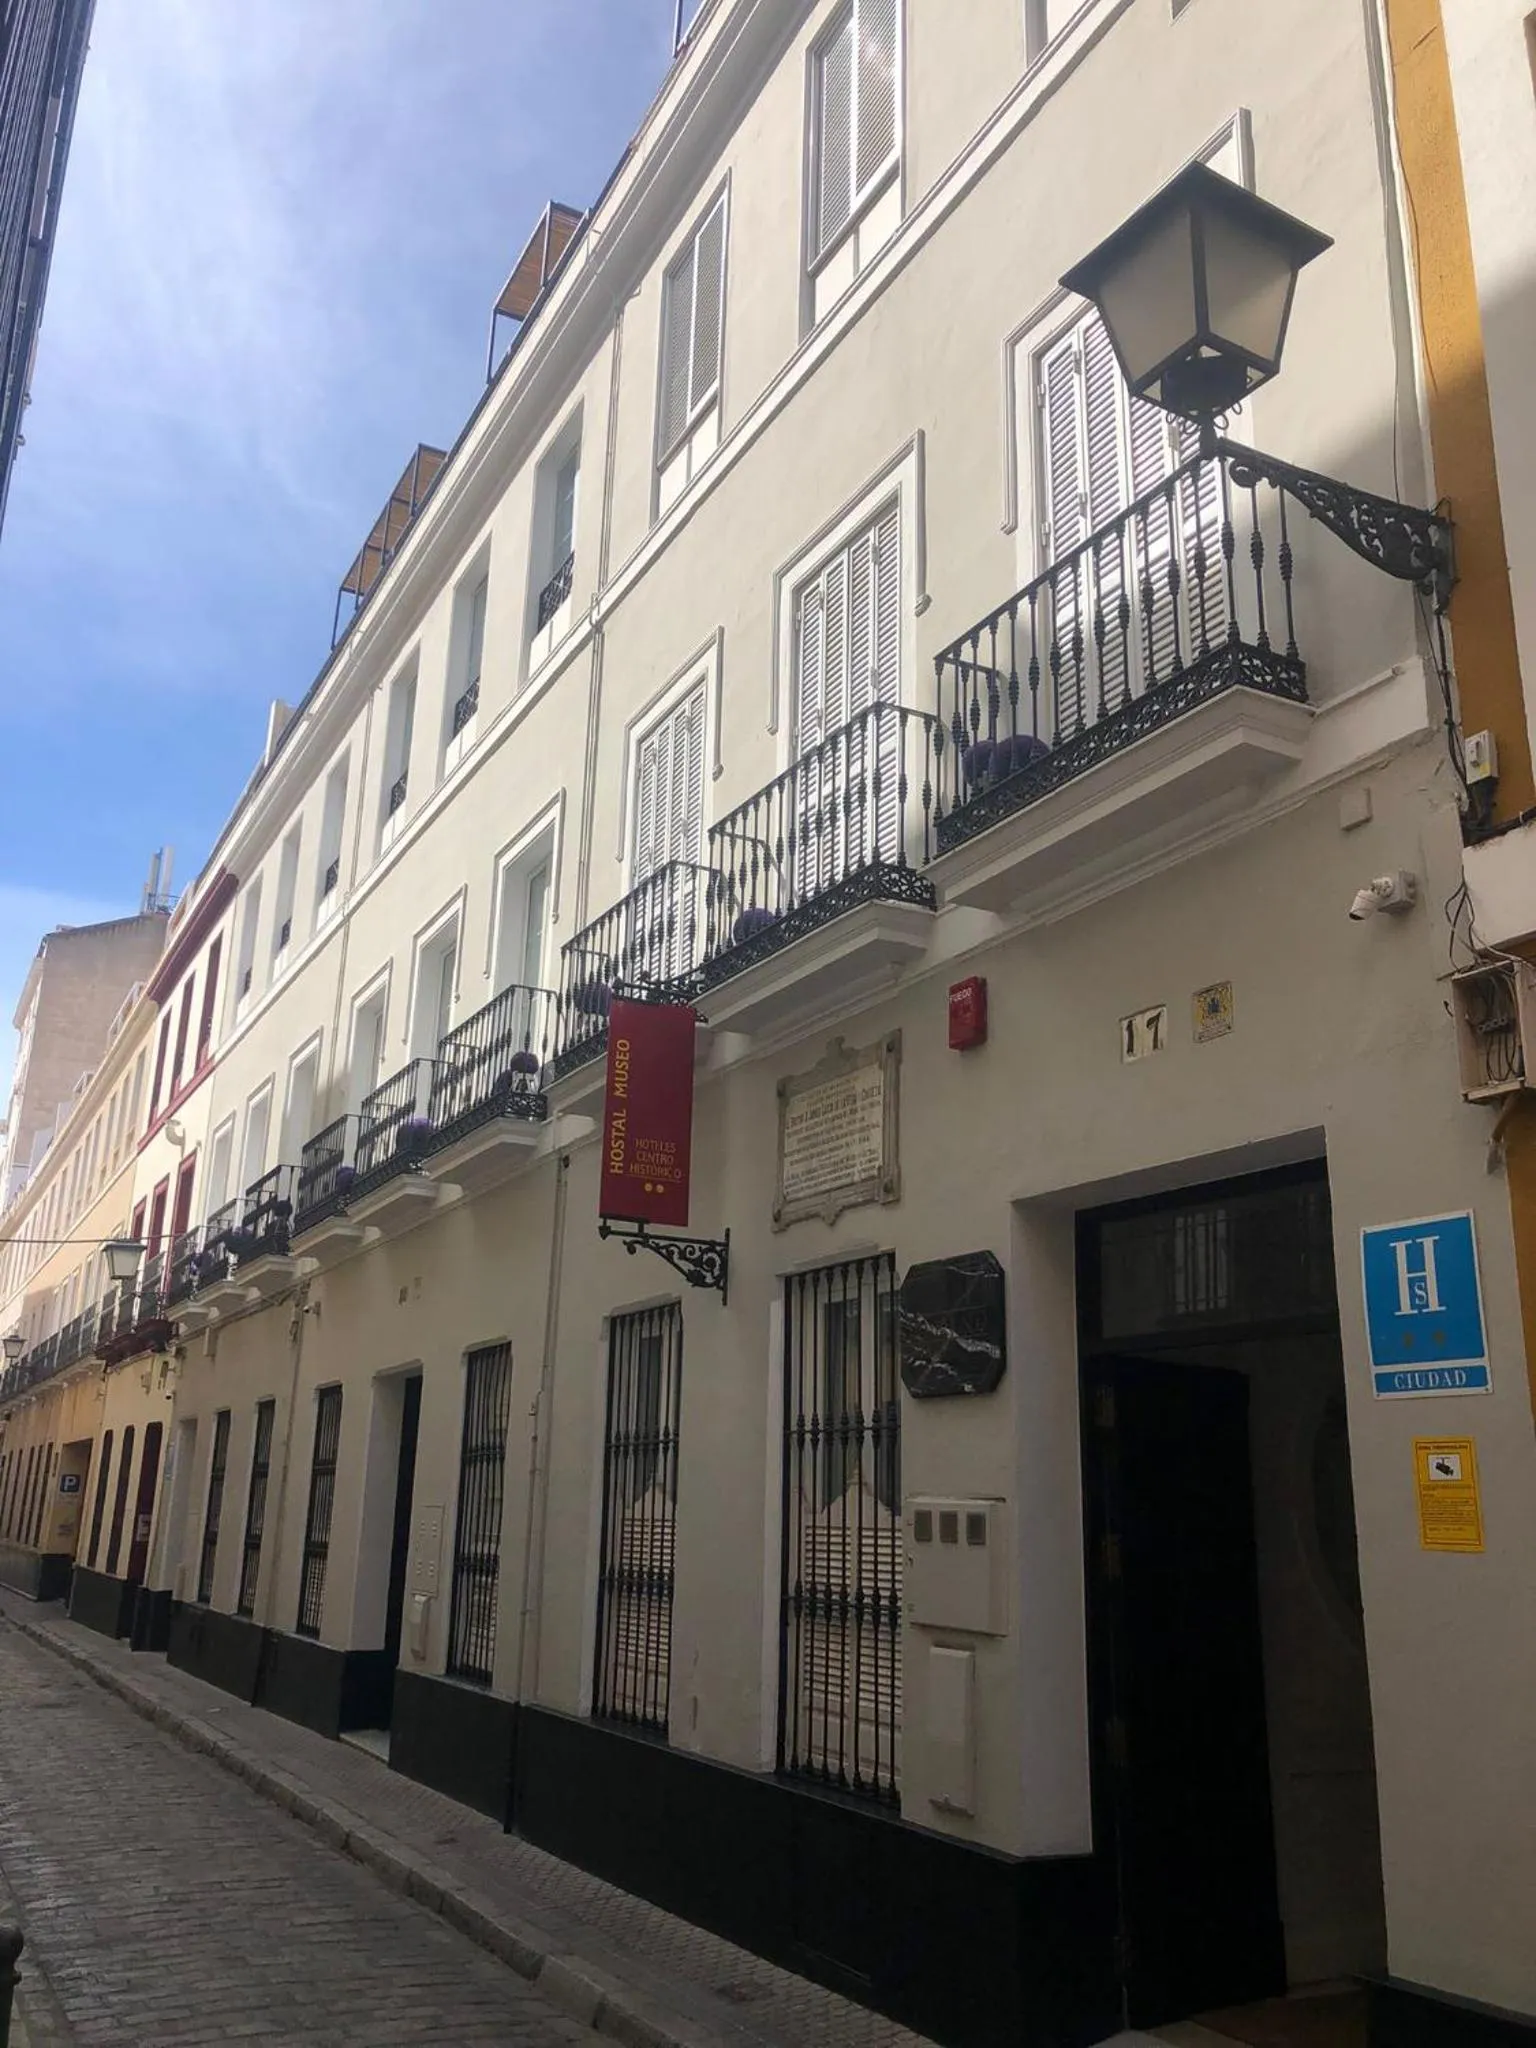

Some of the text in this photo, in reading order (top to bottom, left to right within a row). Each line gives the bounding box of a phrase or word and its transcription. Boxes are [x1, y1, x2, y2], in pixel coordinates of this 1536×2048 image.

[1126, 1011, 1163, 1057] 17
[610, 1039, 631, 1175] HOSTAL MUSEO
[634, 1138, 677, 1153] HOTELES
[636, 1150, 674, 1165] CENTRO
[1394, 1369, 1467, 1390] CIUDAD
[64, 1475, 76, 1491] P
